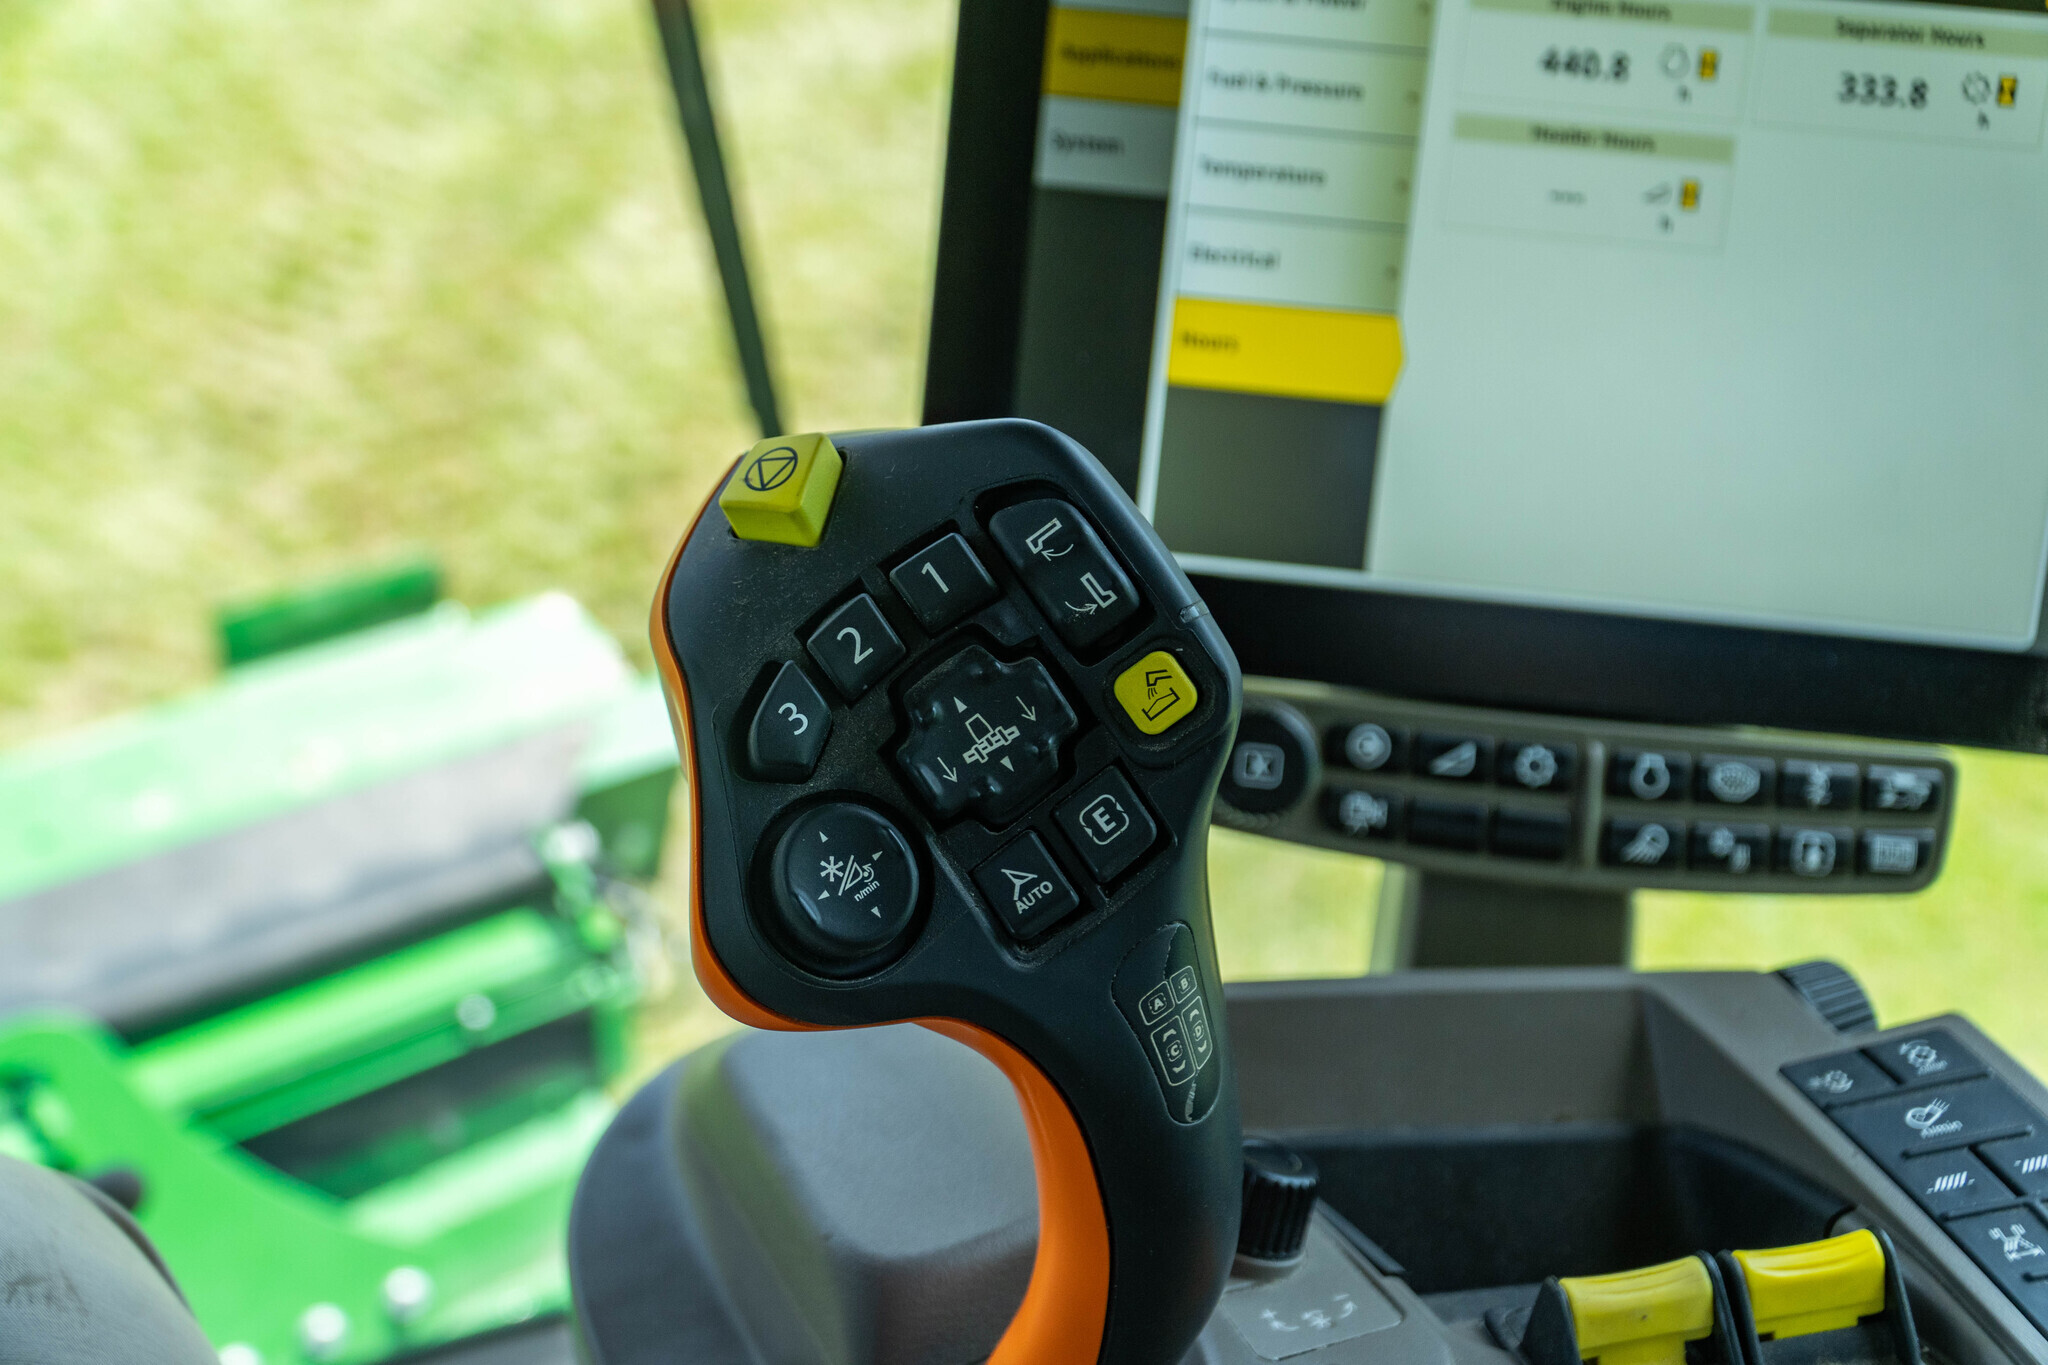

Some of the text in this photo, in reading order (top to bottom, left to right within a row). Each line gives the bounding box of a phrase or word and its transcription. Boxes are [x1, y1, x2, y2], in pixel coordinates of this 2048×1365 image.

[1617, 2, 1673, 21] Hours
[1836, 17, 1986, 47] Separator Hours
[1541, 47, 1630, 83] 440.8
[1207, 69, 1247, 90] Fuel
[1278, 73, 1364, 100] Pressure
[1839, 71, 1928, 110] 333.8
[1053, 130, 1124, 155] System
[1204, 158, 1326, 186] Temperature
[1190, 244, 1280, 270] Electrical
[921, 562, 949, 593] 1
[837, 626, 874, 664] 2
[778, 703, 809, 735] 3
[1092, 806, 1116, 833] E
[854, 880, 881, 902] n/min
[1015, 880, 1053, 914] AUTO
[1180, 977, 1189, 991] B
[1154, 998, 1164, 1011] A
[1170, 1044, 1180, 1056] C
